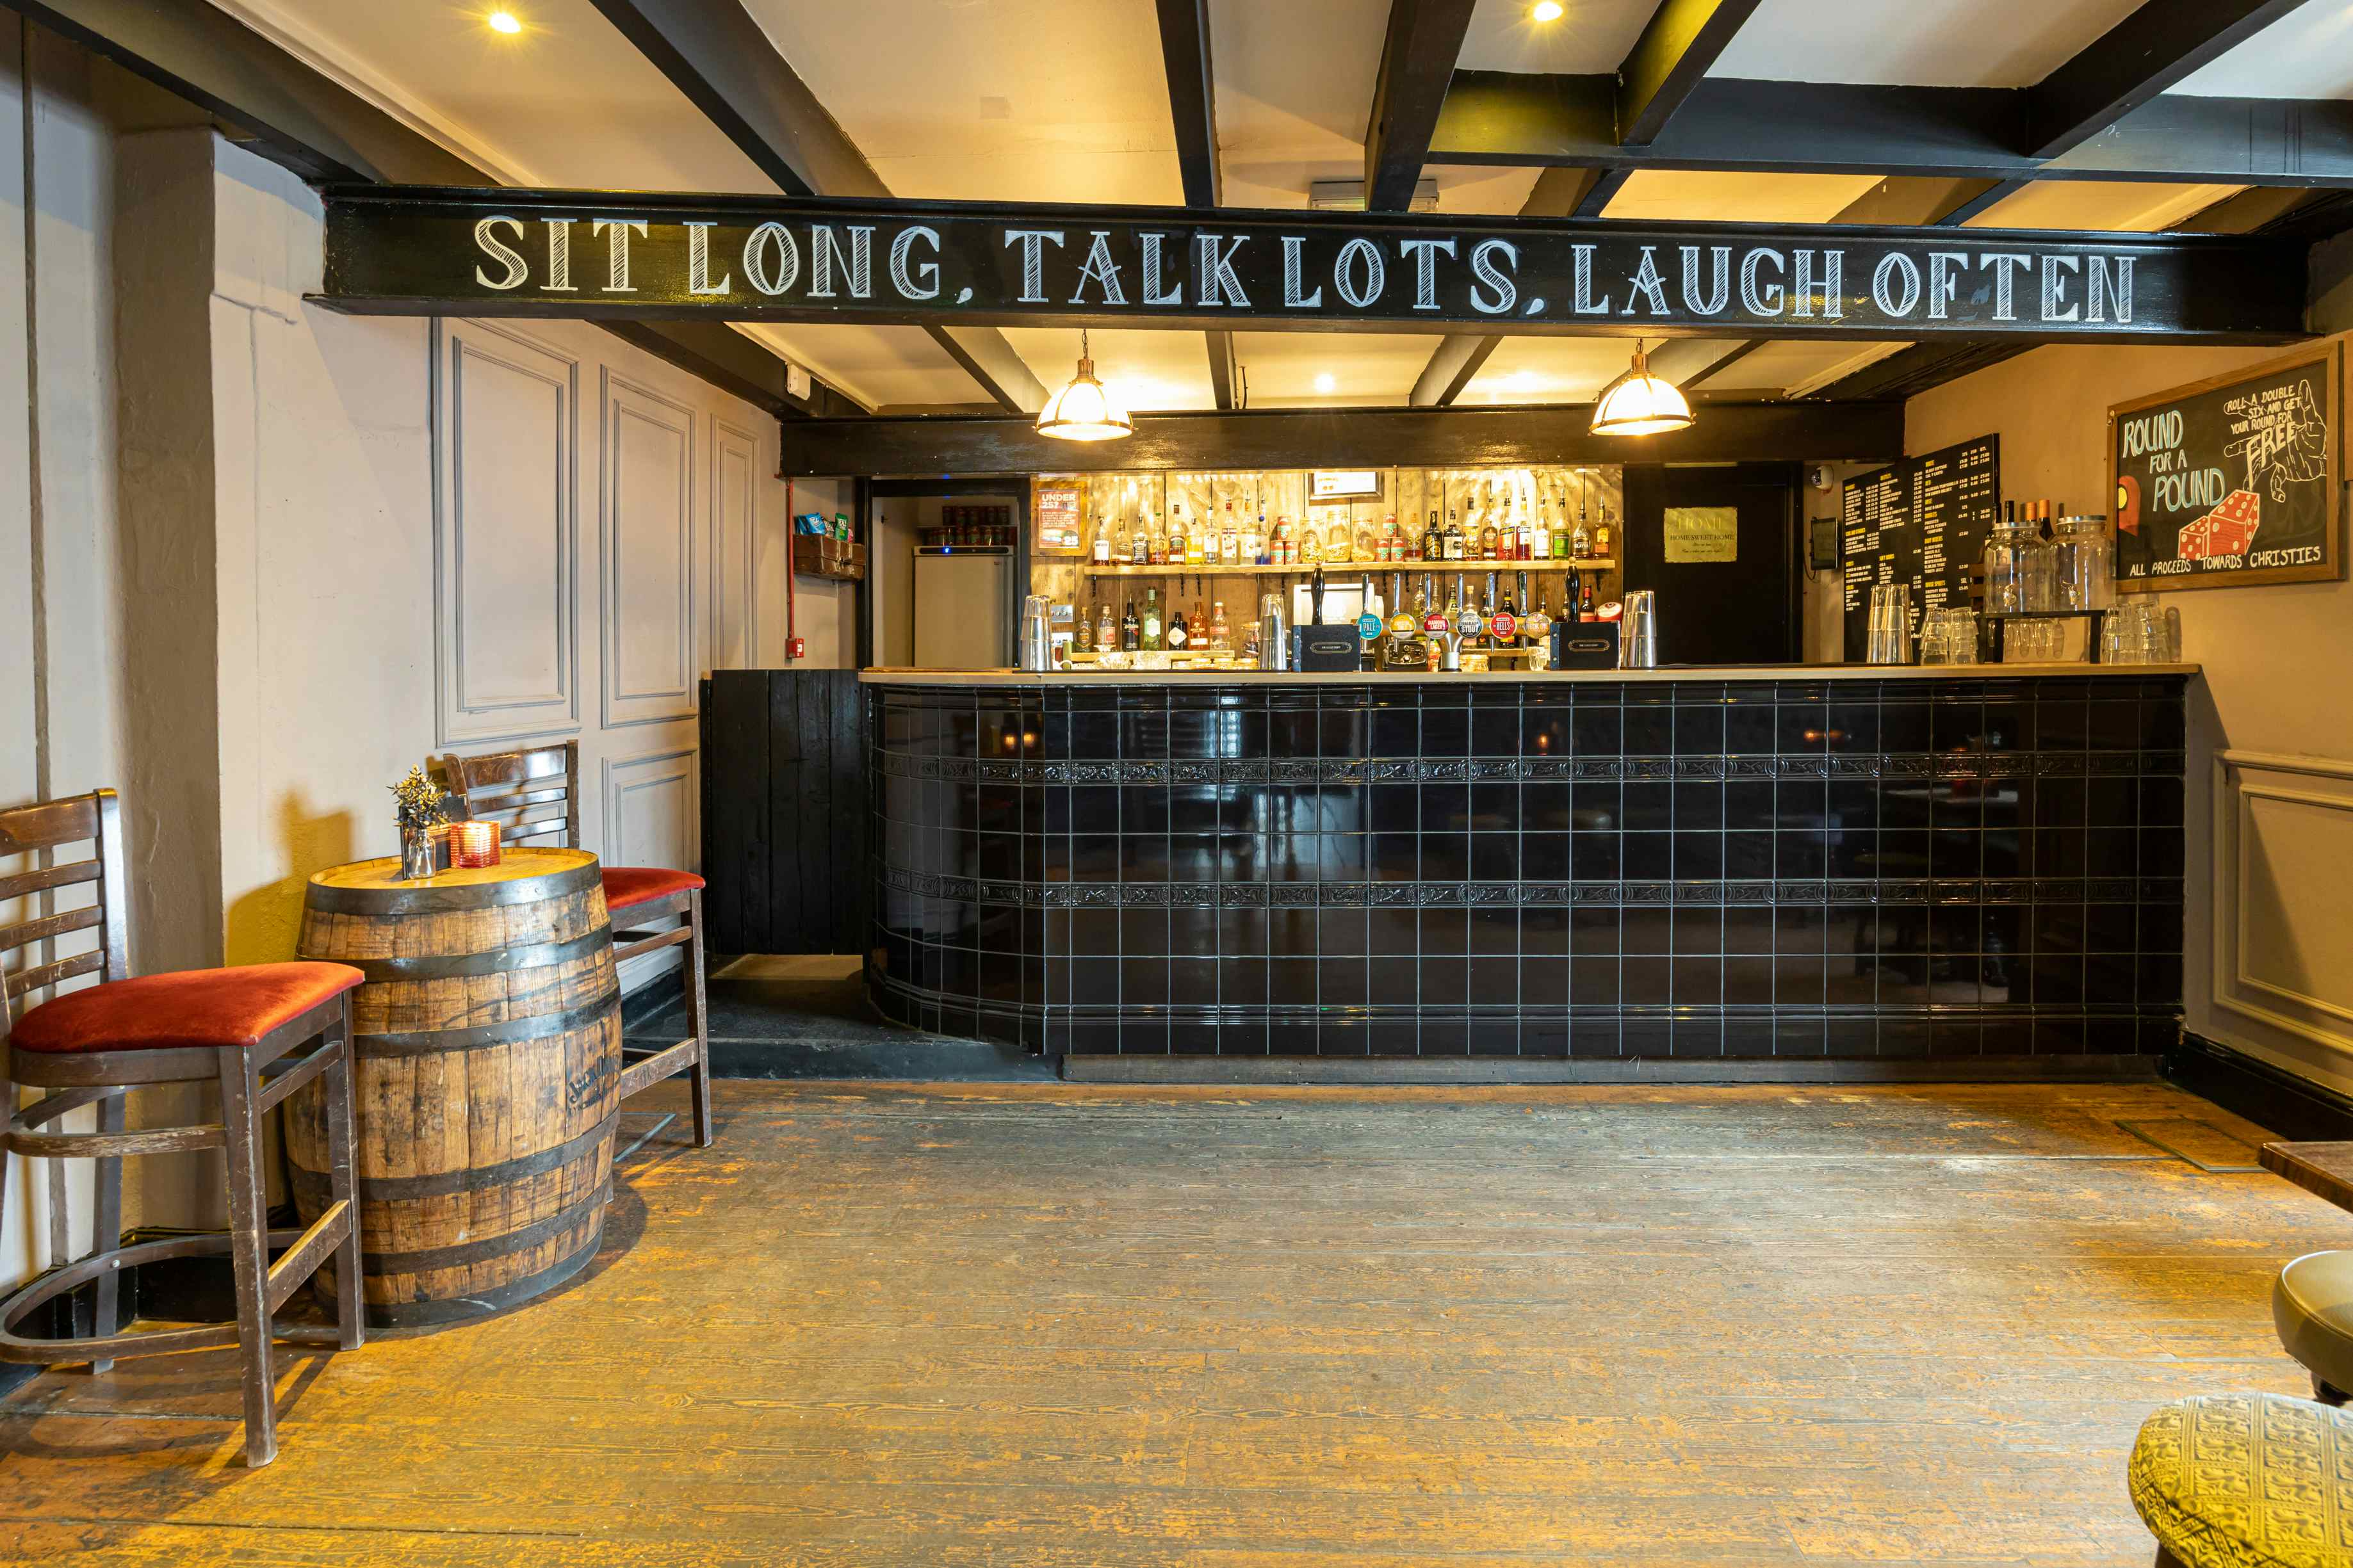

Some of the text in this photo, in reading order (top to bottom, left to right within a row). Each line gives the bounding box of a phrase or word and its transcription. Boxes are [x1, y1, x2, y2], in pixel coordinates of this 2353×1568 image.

[474, 215, 2137, 323] SIT LONG, TALK LOTS, LAUGH OFTEN
[2227, 385, 2295, 412] ROLL A DOUBLE
[2248, 397, 2301, 419] SIX AND GET
[2122, 410, 2183, 458] ROUND
[2231, 410, 2293, 435] YOUR ROUND FOR
[2149, 449, 2188, 474] FOR A
[2246, 421, 2296, 492] FREE
[2153, 467, 2226, 512] POUND
[2129, 546, 2321, 577] ALL PROCEEDS TOWARDS CHRISTIES
[1363, 622, 1376, 631] PALE
[1496, 620, 1510, 631] HELLS
